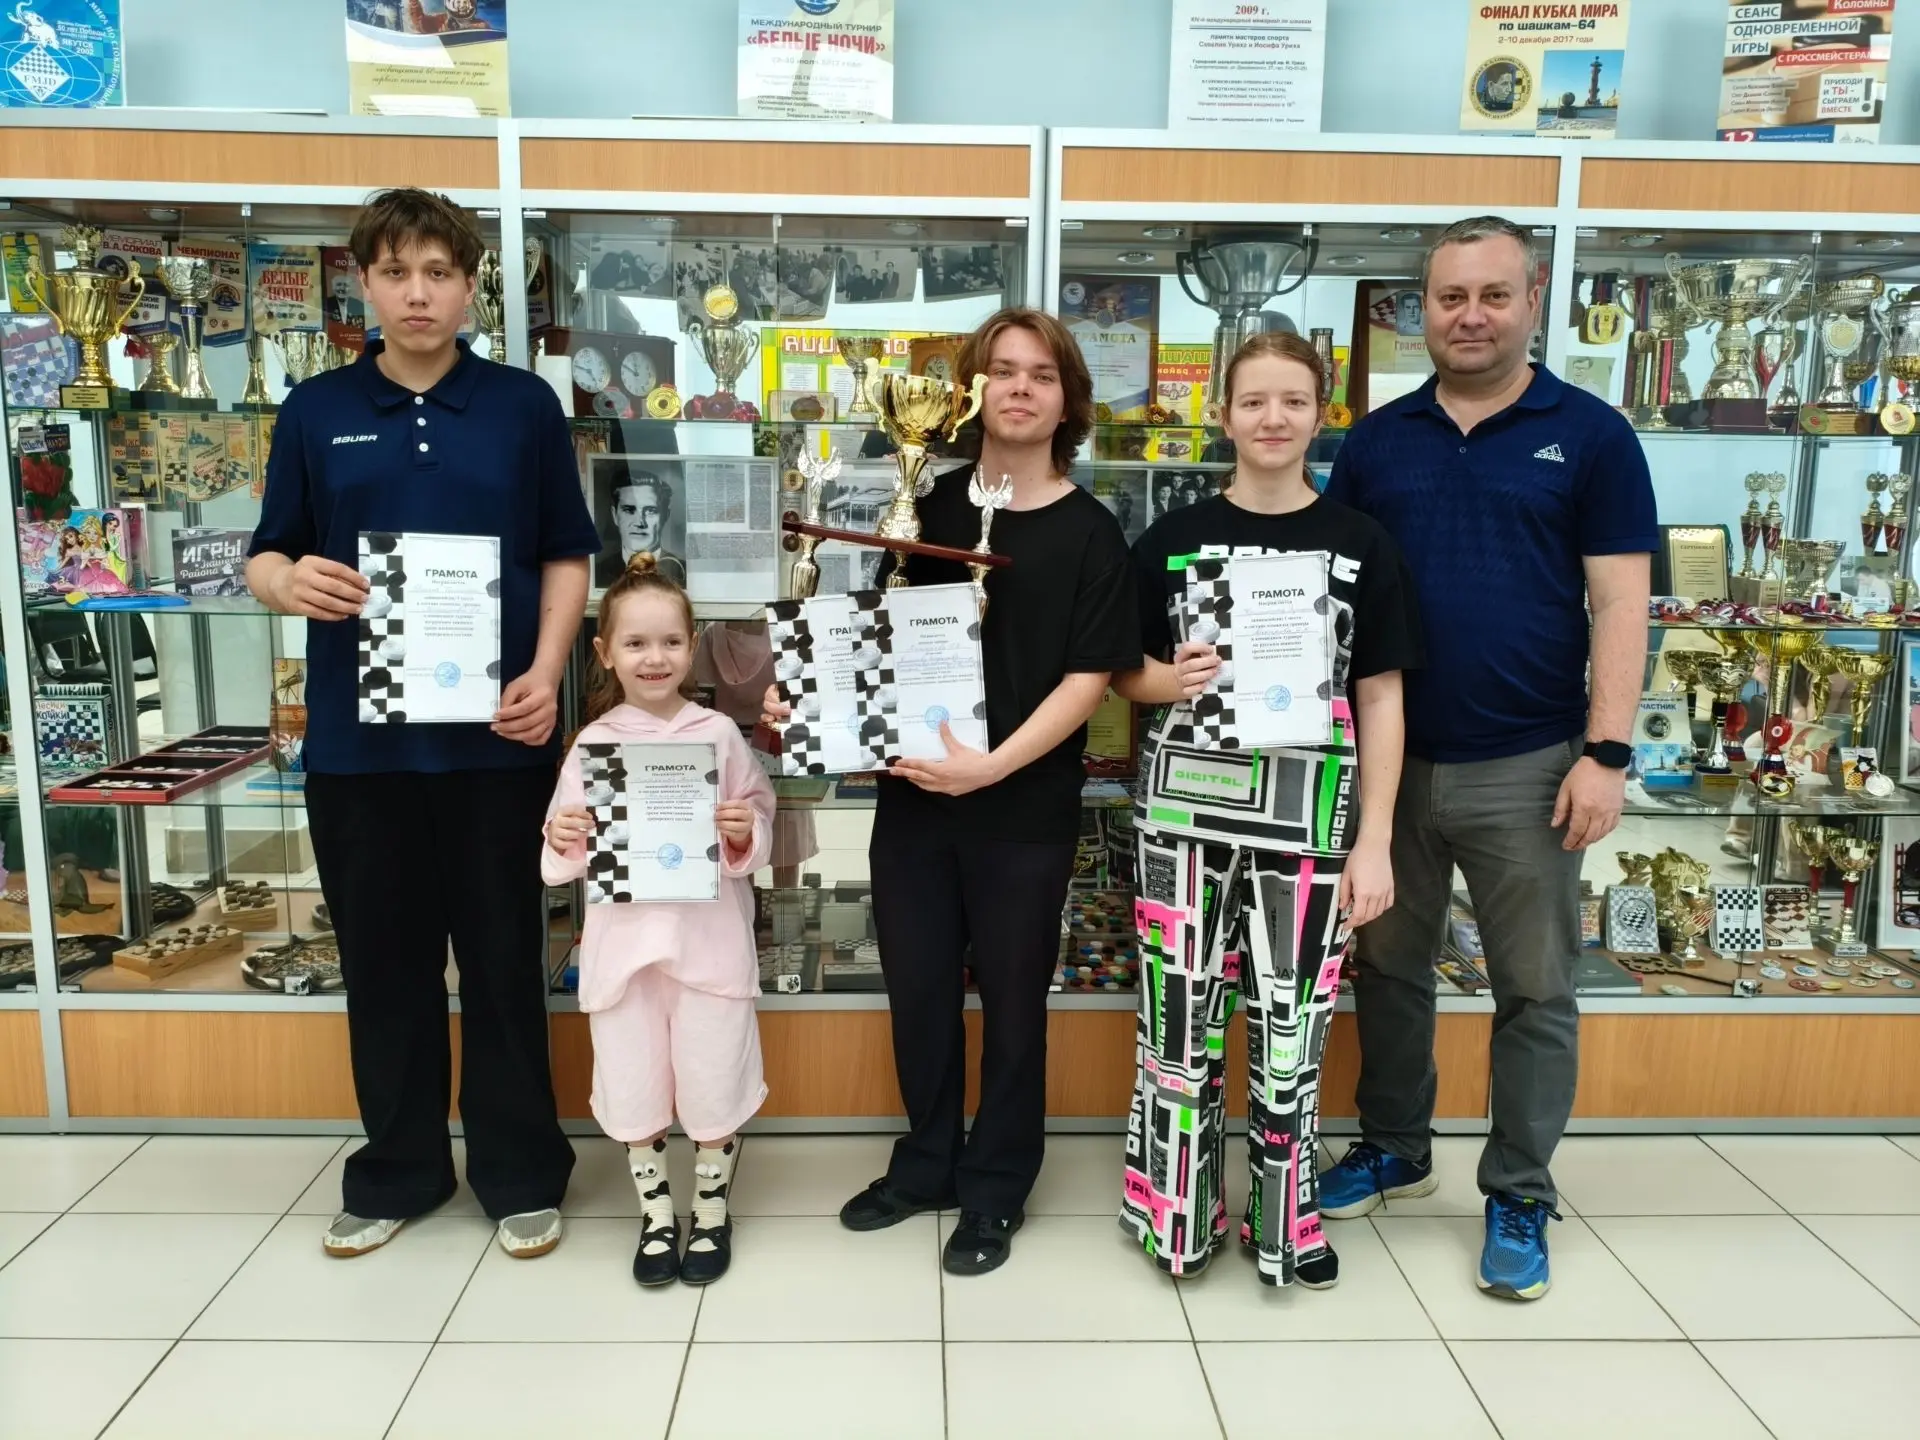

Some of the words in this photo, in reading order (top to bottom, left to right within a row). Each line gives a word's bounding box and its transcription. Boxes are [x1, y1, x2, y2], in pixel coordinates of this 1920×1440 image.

[1235, 5, 1259, 15] 2009
[1480, 5, 1530, 19] ФИНАЛ
[1533, 4, 1577, 18] КУБКА
[1580, 3, 1619, 18] МИРА
[1735, 6, 1780, 19] СЕАНС
[751, 18, 843, 30] МЕЖДУНАРОДНЫЙ
[845, 23, 882, 32] ТУРНИР
[1499, 22, 1514, 31] по
[1733, 18, 1859, 38] ОДНОВРЕМЕННОЙ
[1519, 36, 1551, 44] декабря
[1732, 42, 1769, 54] ИГРЫ
[1777, 54, 1785, 63] С
[24, 75, 57, 86] FMJD
[1824, 77, 1863, 86] ПРИХОДИ
[1831, 87, 1848, 96] ТЫ
[1822, 97, 1860, 105] СЫГРАЕМ
[122, 242, 163, 257] СОКОВА
[177, 245, 241, 260] ЧЕМПИОНАТ
[262, 269, 310, 286] БЕЛЫЕ
[267, 286, 305, 302] НОЧИ
[332, 434, 378, 445] BAUER
[1533, 452, 1566, 463] adidas
[182, 539, 242, 564] ИГРЫ
[425, 568, 478, 579] ГРАМОТА
[1251, 588, 1306, 600] ГРАМОТА
[909, 616, 959, 627] ГРАМОТА
[1639, 702, 1676, 711] ЧАСТНИК
[644, 764, 697, 772] ГРАМОТА
